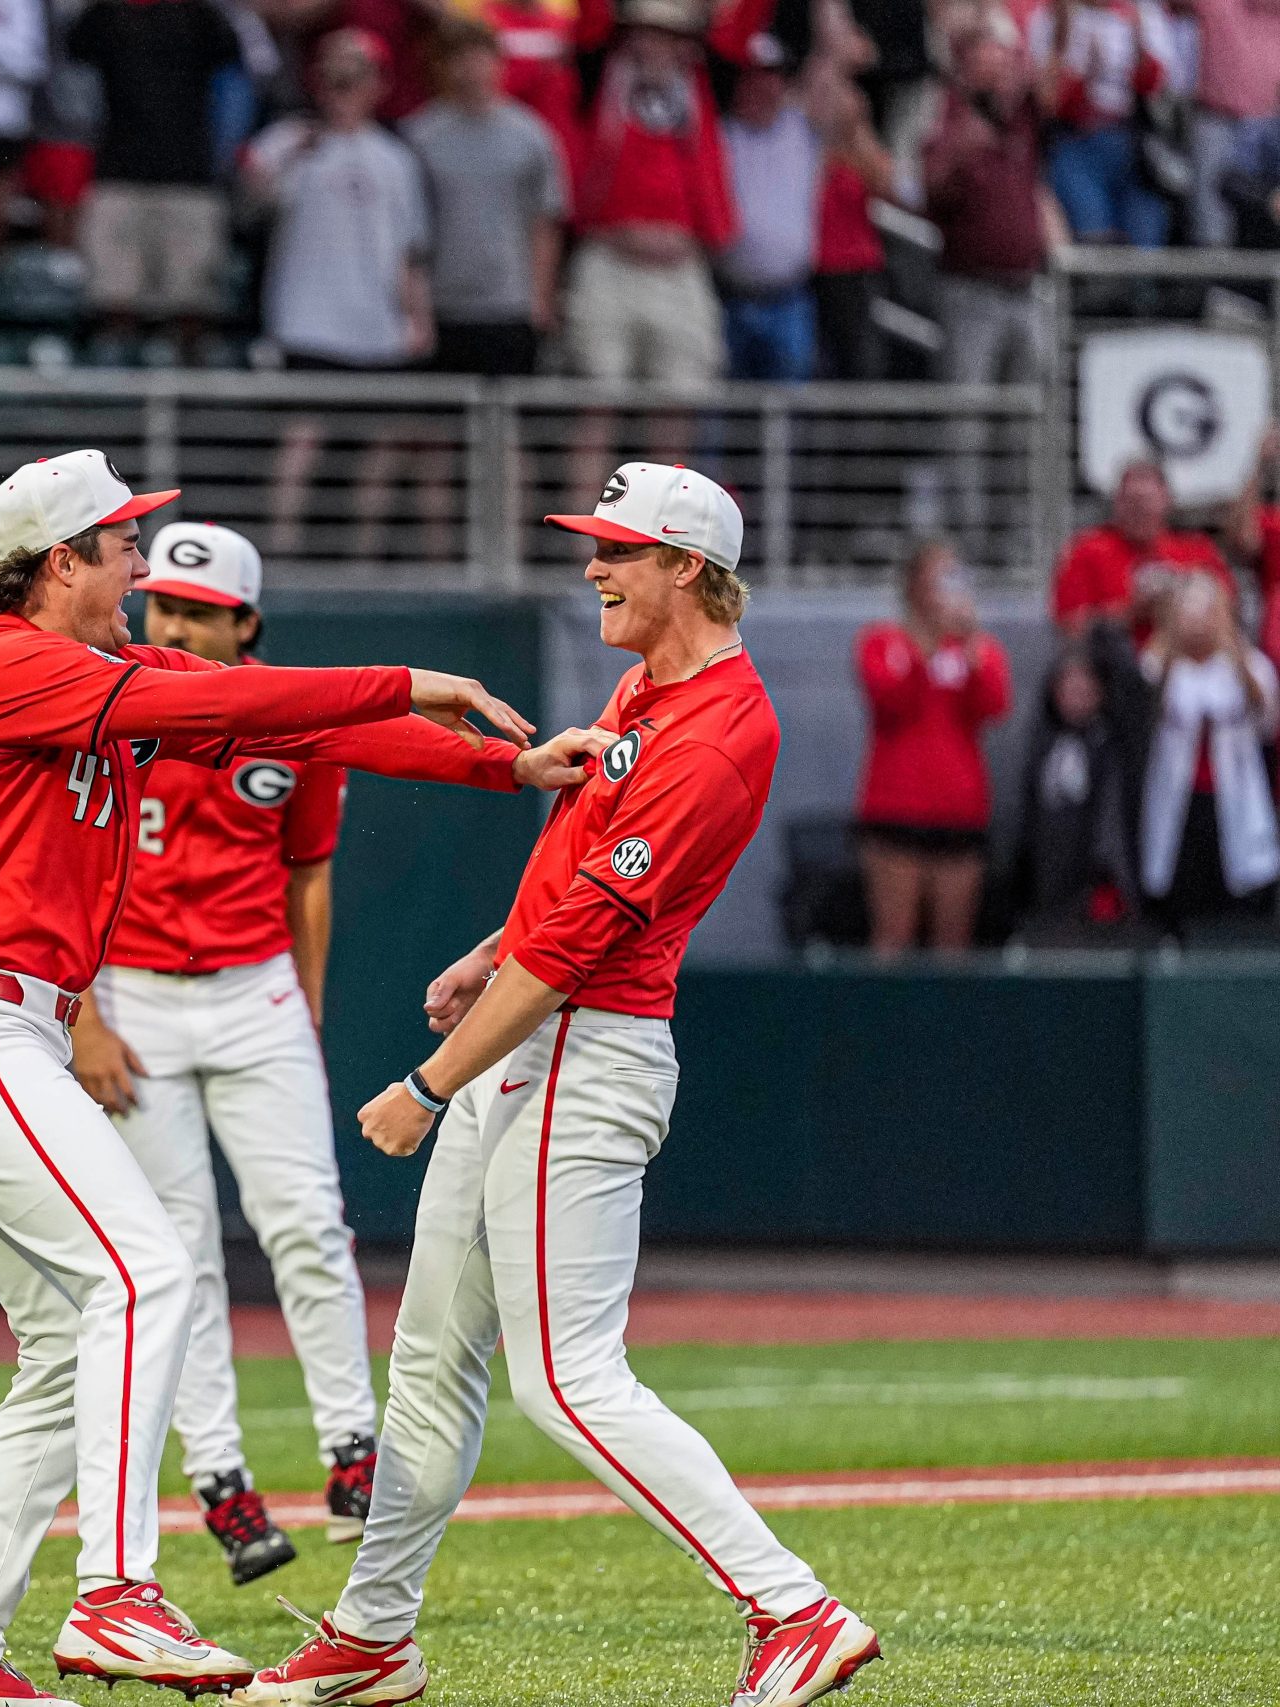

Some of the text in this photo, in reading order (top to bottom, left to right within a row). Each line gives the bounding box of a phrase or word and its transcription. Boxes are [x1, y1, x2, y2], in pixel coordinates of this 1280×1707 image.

[171, 542, 212, 568] G
[244, 764, 298, 802] G
[613, 839, 650, 877] SEC
